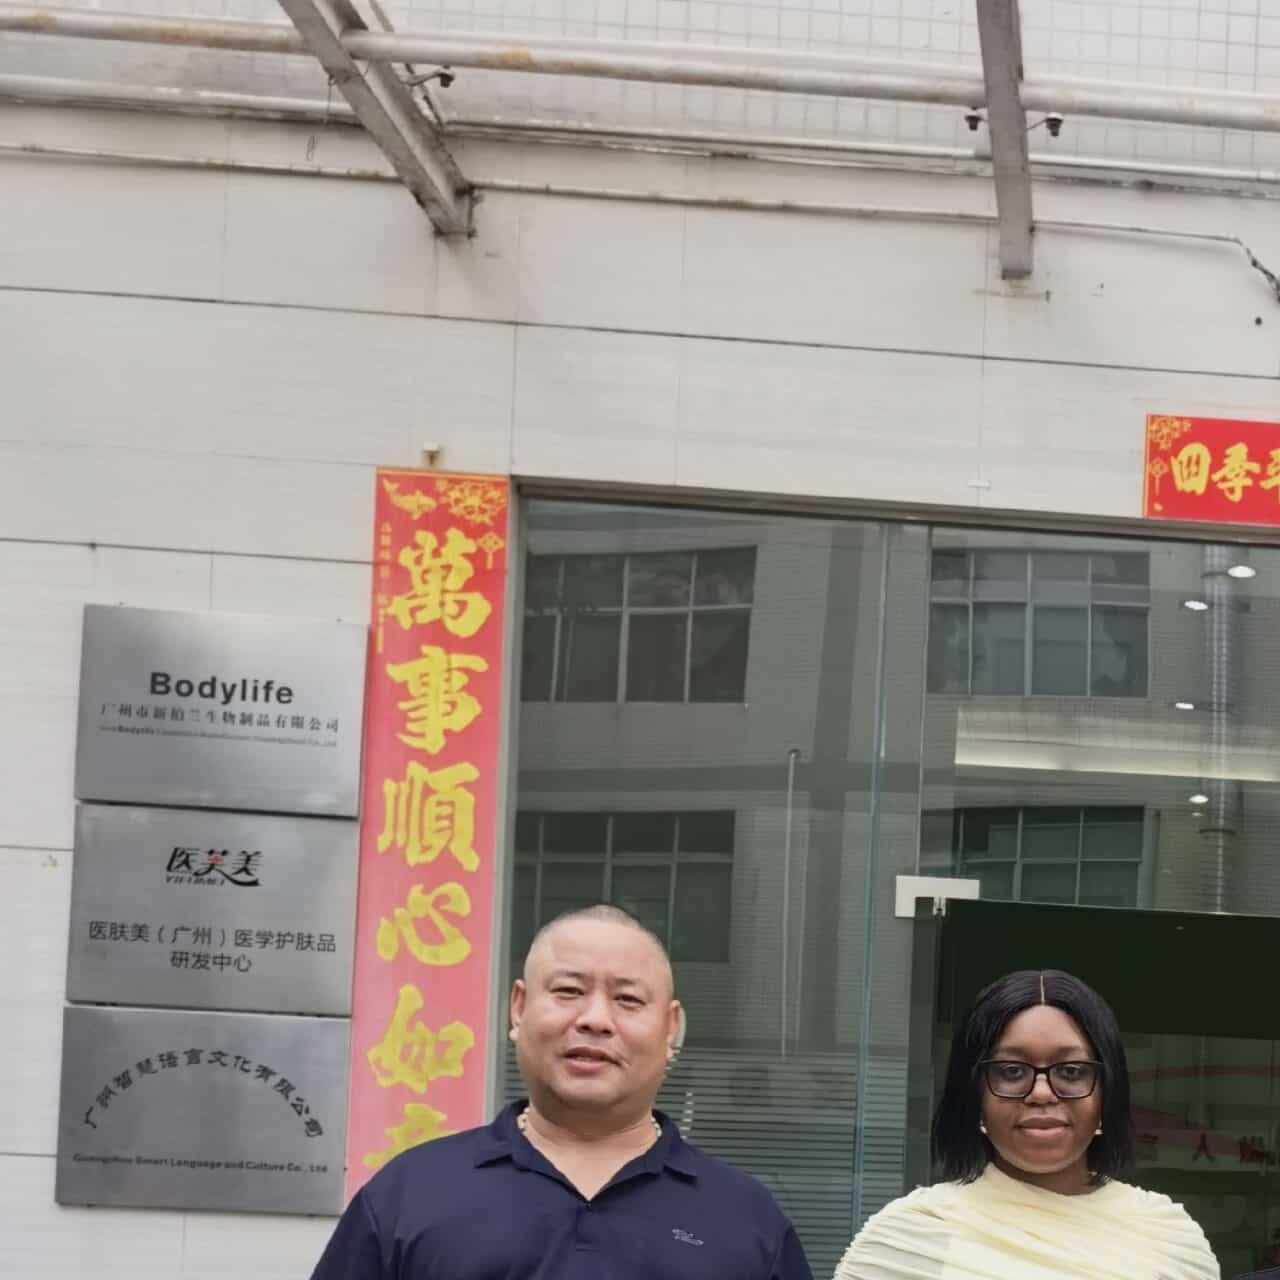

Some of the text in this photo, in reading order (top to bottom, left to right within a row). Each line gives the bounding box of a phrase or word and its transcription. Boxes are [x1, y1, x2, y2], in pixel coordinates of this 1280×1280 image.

[149, 671, 294, 705] Bodylife
[169, 951, 252, 973] 研发中心
